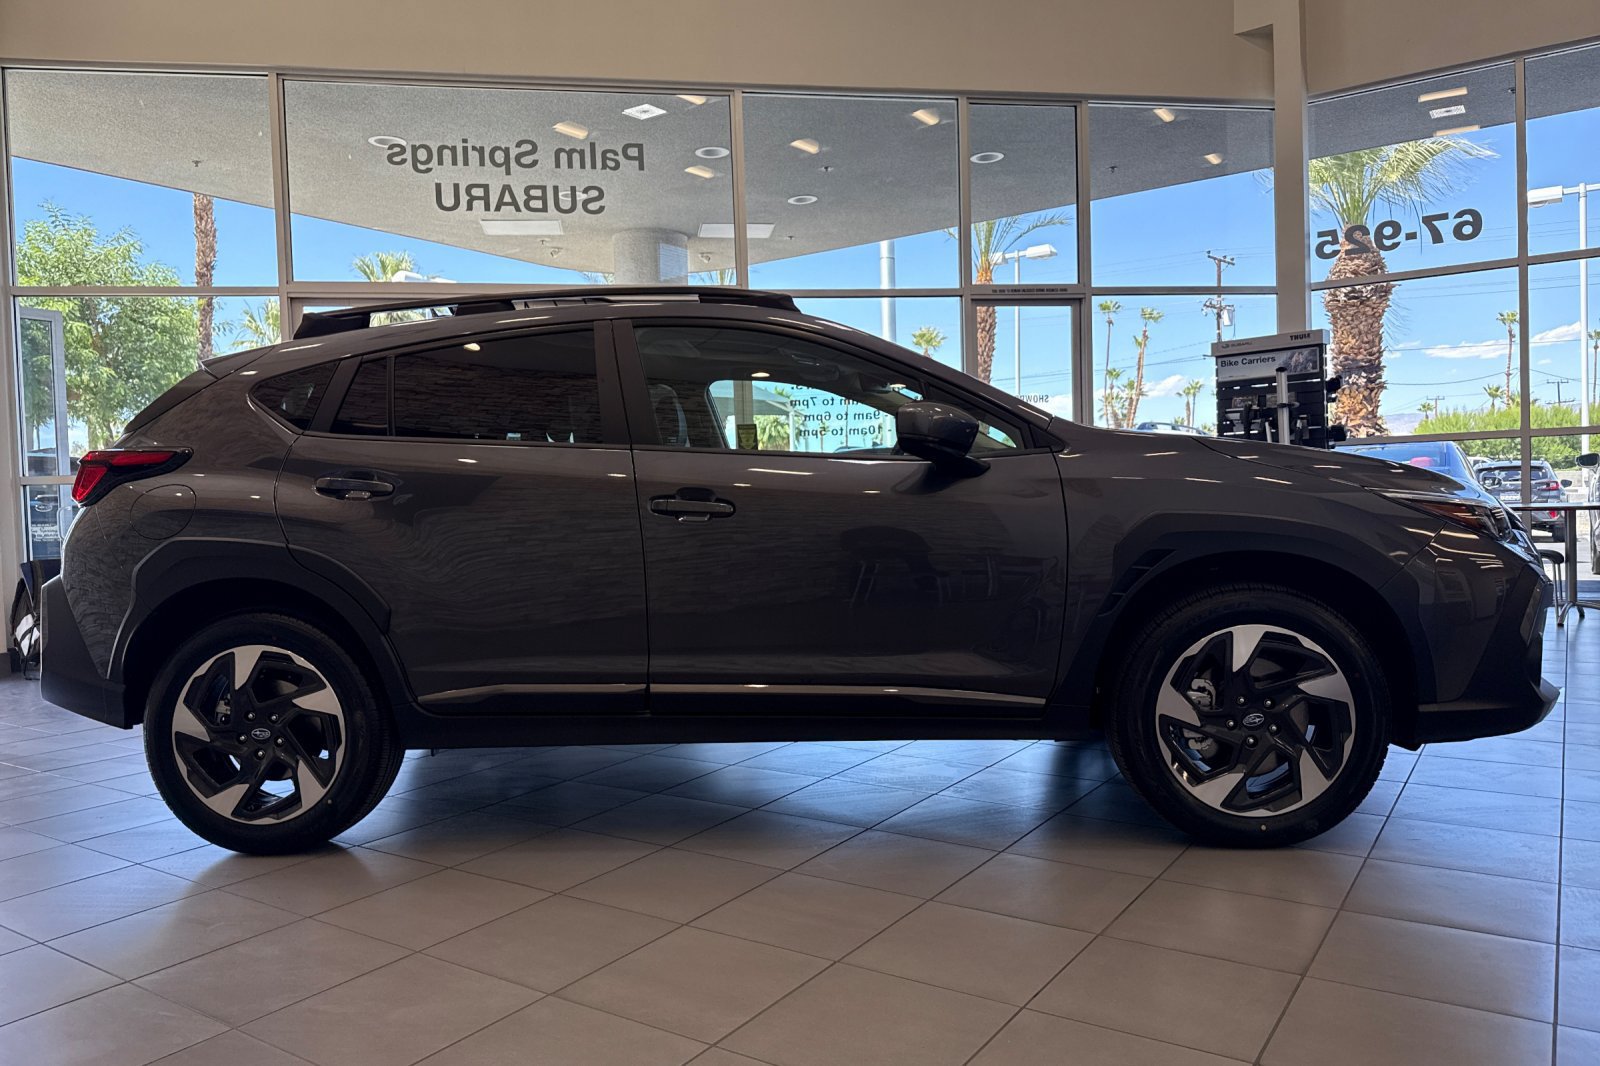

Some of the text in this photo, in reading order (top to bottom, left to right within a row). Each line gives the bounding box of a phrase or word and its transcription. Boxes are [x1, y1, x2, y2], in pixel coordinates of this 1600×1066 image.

[1289, 332, 1311, 341] THULE
[1220, 355, 1276, 368] Bike Carriers
